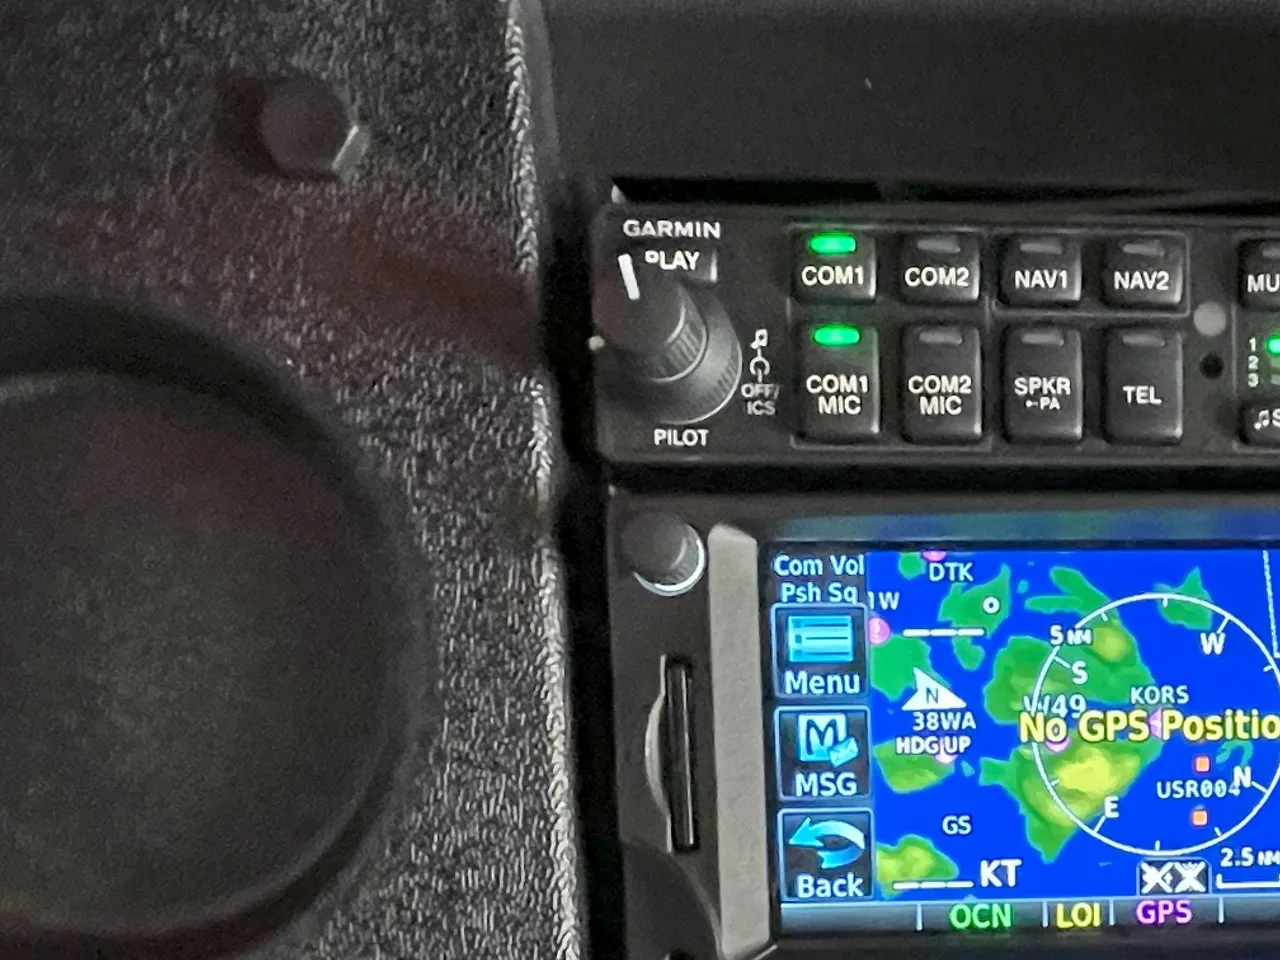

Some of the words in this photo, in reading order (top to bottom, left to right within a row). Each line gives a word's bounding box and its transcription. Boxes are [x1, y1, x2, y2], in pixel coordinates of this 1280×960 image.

[623, 219, 721, 239] GARMIN
[802, 266, 864, 287] COM1
[905, 267, 970, 288] COM2
[1014, 270, 1068, 289] NAV1
[1114, 271, 1169, 290] NAV2
[1249, 338, 1257, 351] 1
[1248, 356, 1259, 369] 2
[806, 375, 869, 393] COM1
[908, 375, 972, 394] COM2
[1014, 377, 1071, 396] SPKR
[1248, 373, 1259, 388] 3
[819, 395, 861, 415] MIC
[1040, 397, 1060, 411] PA
[1123, 385, 1161, 405] TEL
[746, 400, 776, 416] ICS
[920, 396, 962, 415] MIC
[654, 428, 709, 446] PILOT
[773, 555, 823, 576] Com
[830, 554, 864, 576] Vol
[929, 563, 973, 582] DTK
[781, 582, 821, 603] Psh
[828, 582, 858, 604] Sq
[1200, 633, 1225, 655] W
[785, 670, 860, 695] Menu
[1072, 662, 1088, 684] S
[1130, 685, 1189, 705] KORS
[912, 712, 976, 730] 38WA
[1020, 713, 1067, 743] No
[1078, 709, 1150, 742] GPS
[896, 737, 939, 754] HDG
[944, 736, 971, 753] UP
[795, 773, 858, 797] MSG
[1233, 765, 1251, 788] N
[1104, 796, 1120, 818] E
[942, 815, 972, 835] GS
[1220, 848, 1253, 867] 2.5
[980, 859, 1022, 887] KT
[797, 872, 863, 898] Back
[949, 904, 1012, 929] OCN
[1056, 903, 1100, 928] LOI
[1136, 900, 1193, 924] GPS
